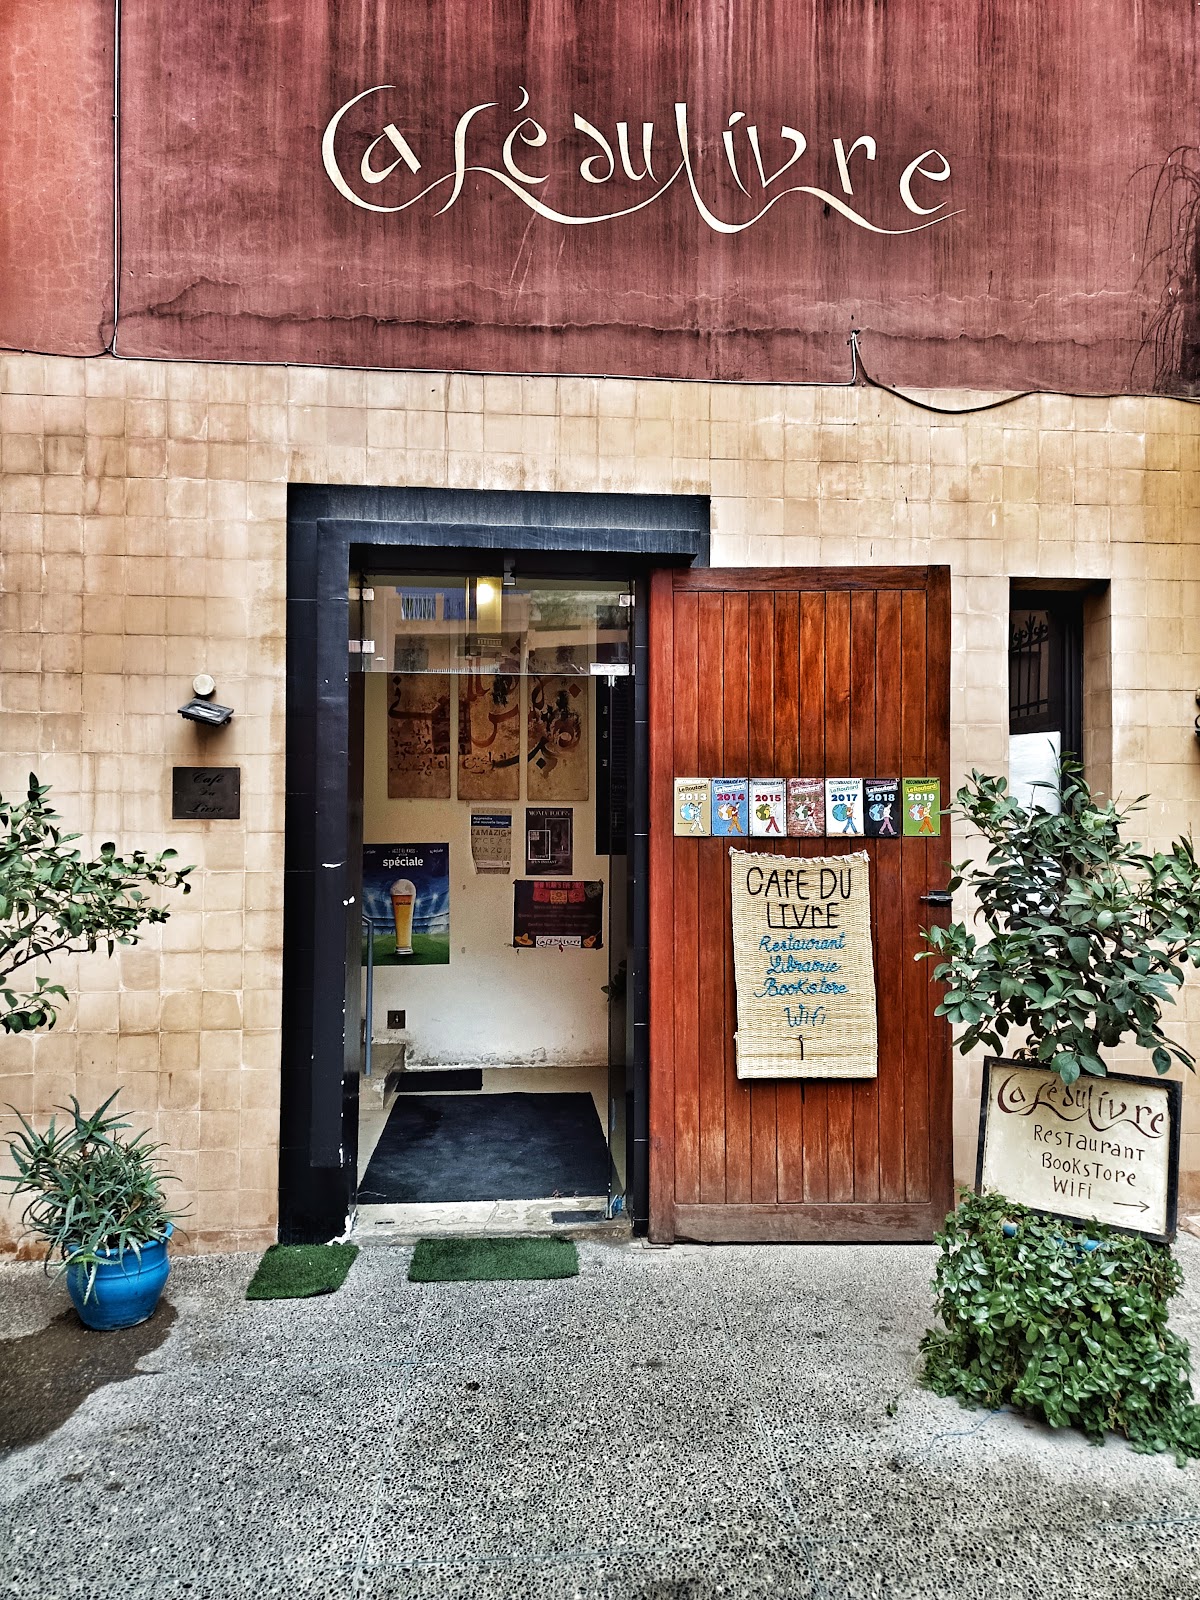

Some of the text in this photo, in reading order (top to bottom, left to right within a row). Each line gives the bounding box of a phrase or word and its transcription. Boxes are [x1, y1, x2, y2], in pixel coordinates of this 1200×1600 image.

[679, 793, 707, 801] 2013
[755, 794, 781, 802] 2015
[831, 793, 858, 802] 2017
[867, 793, 895, 802] 2018
[908, 793, 935, 801] 2019
[382, 857, 424, 869] spéciale
[820, 868, 851, 900] DU
[759, 932, 845, 953] Restaurant
[754, 977, 849, 998] Bookstore
